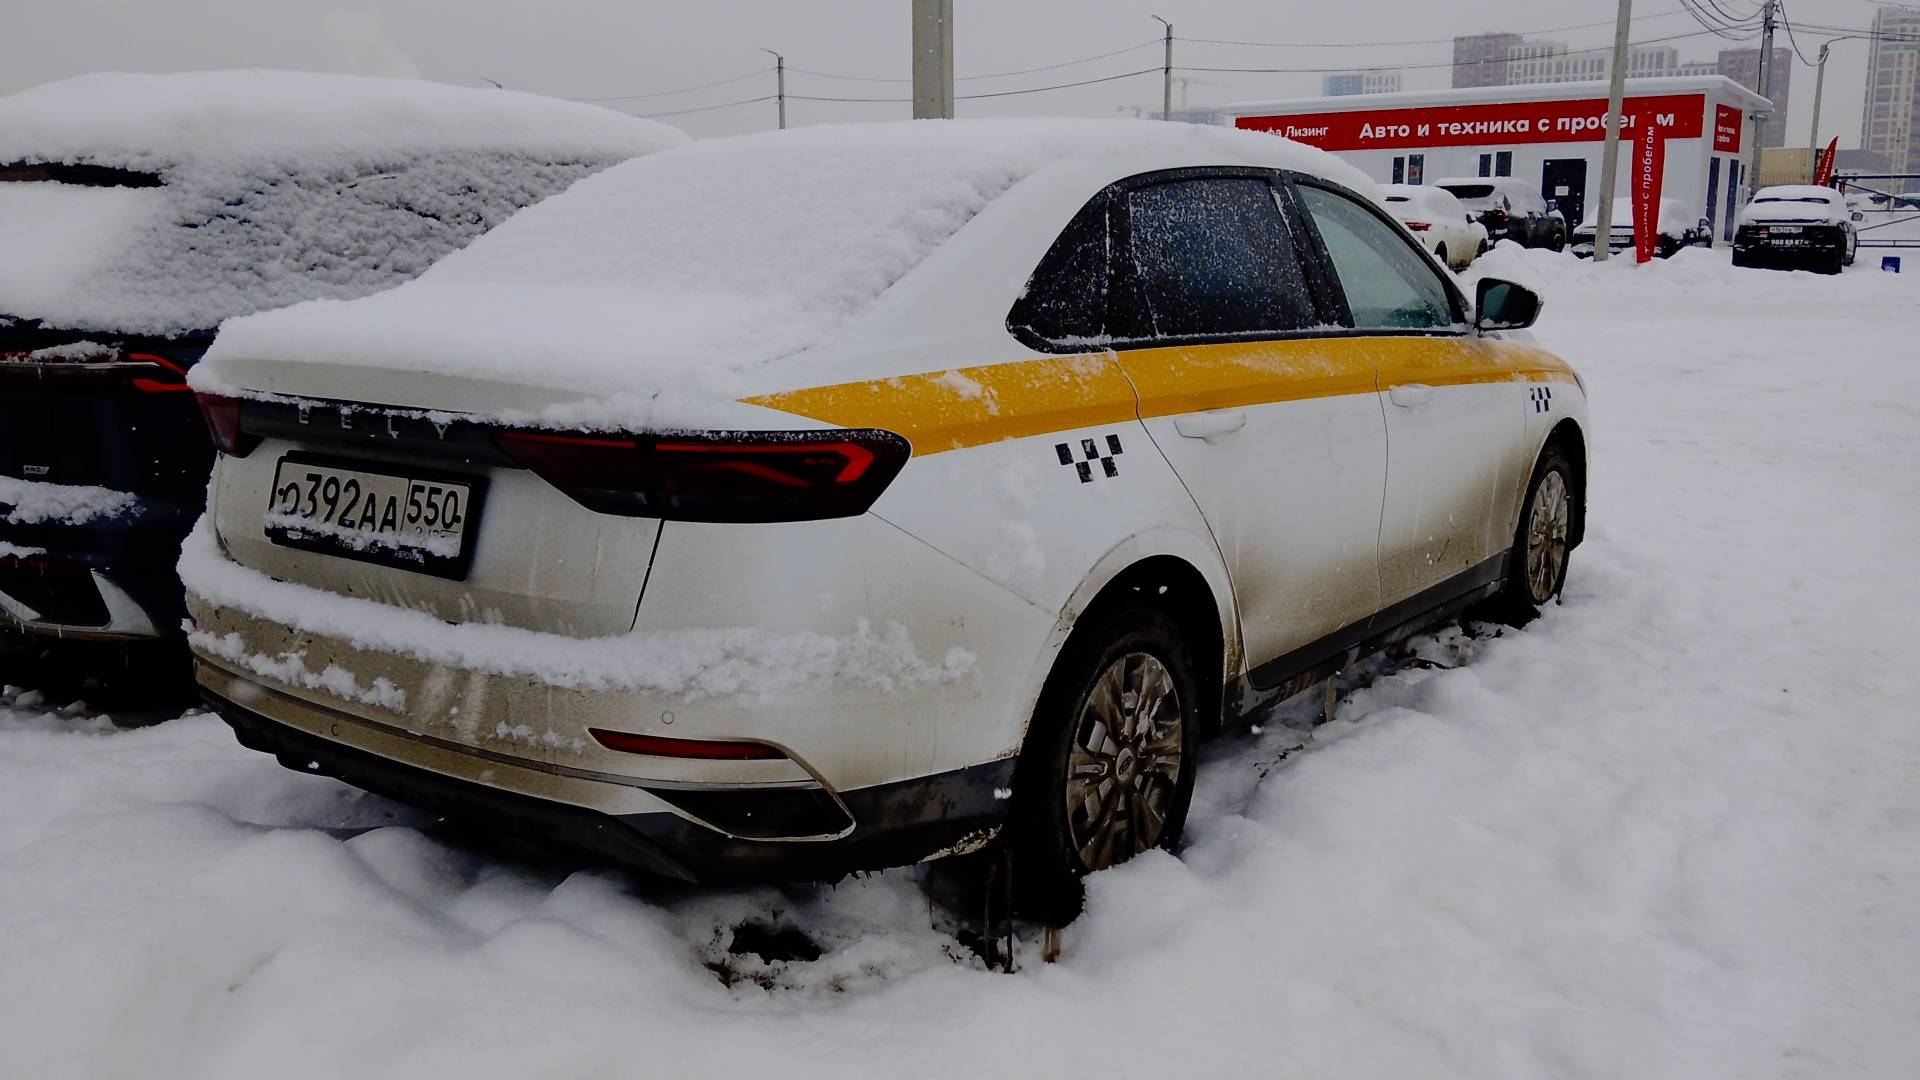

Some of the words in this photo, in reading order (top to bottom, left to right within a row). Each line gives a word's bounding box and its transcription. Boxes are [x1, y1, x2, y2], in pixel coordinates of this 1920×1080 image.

[1285, 126, 1329, 137] Лизинг
[1359, 123, 1410, 139] Авто
[1417, 123, 1430, 136] и
[1437, 118, 1530, 135] техника
[1537, 118, 1550, 133] с
[1642, 126, 1655, 189] пробегом
[406, 484, 459, 530] 550
